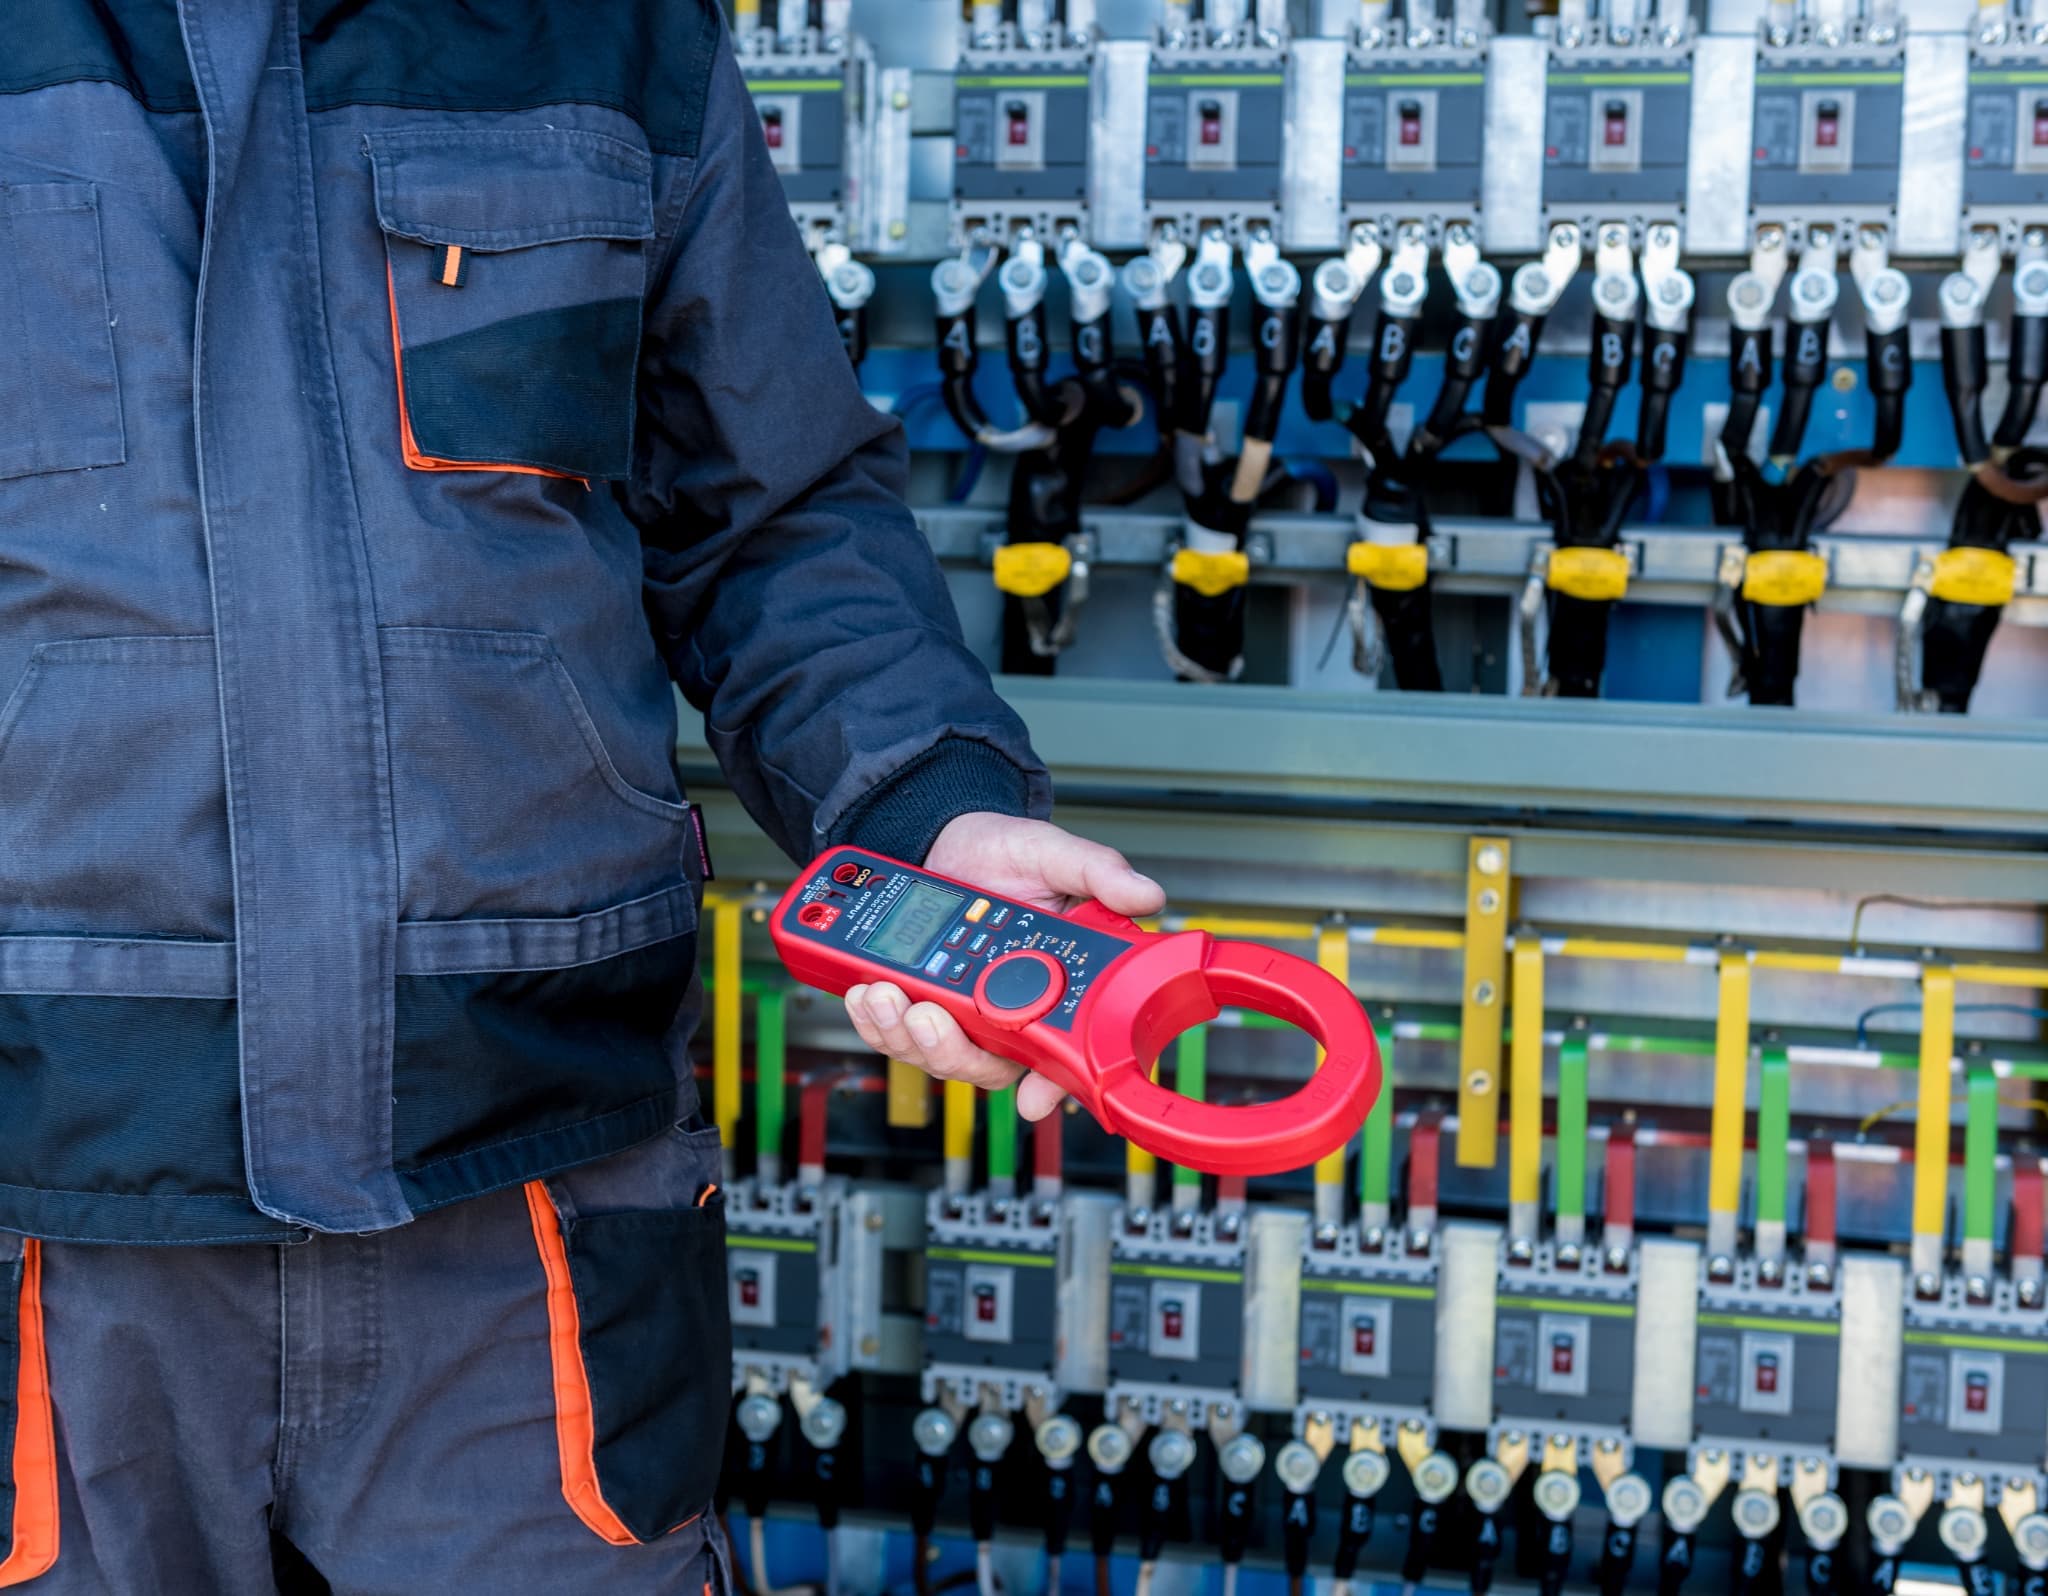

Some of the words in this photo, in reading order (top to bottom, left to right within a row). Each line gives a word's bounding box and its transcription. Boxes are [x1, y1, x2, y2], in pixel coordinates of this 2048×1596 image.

[944, 318, 972, 361] A
[1016, 317, 1041, 362] B
[1150, 316, 1174, 345] A
[1193, 317, 1216, 357] B
[1261, 317, 1283, 348] C
[1310, 324, 1337, 357] A
[1379, 322, 1406, 362] B
[1453, 326, 1477, 362] C
[1503, 322, 1531, 360] A
[1601, 332, 1624, 368] B
[1737, 336, 1763, 375] A
[1796, 328, 1820, 366] B
[850, 867, 873, 887] COM
[884, 874, 909, 899] UT222
[847, 891, 873, 919] OUTPUT
[871, 897, 891, 915] True
[858, 912, 878, 931] RMS
[984, 944, 999, 959] OFF
[1287, 1498, 1309, 1528] A
[1477, 1517, 1499, 1547] A
